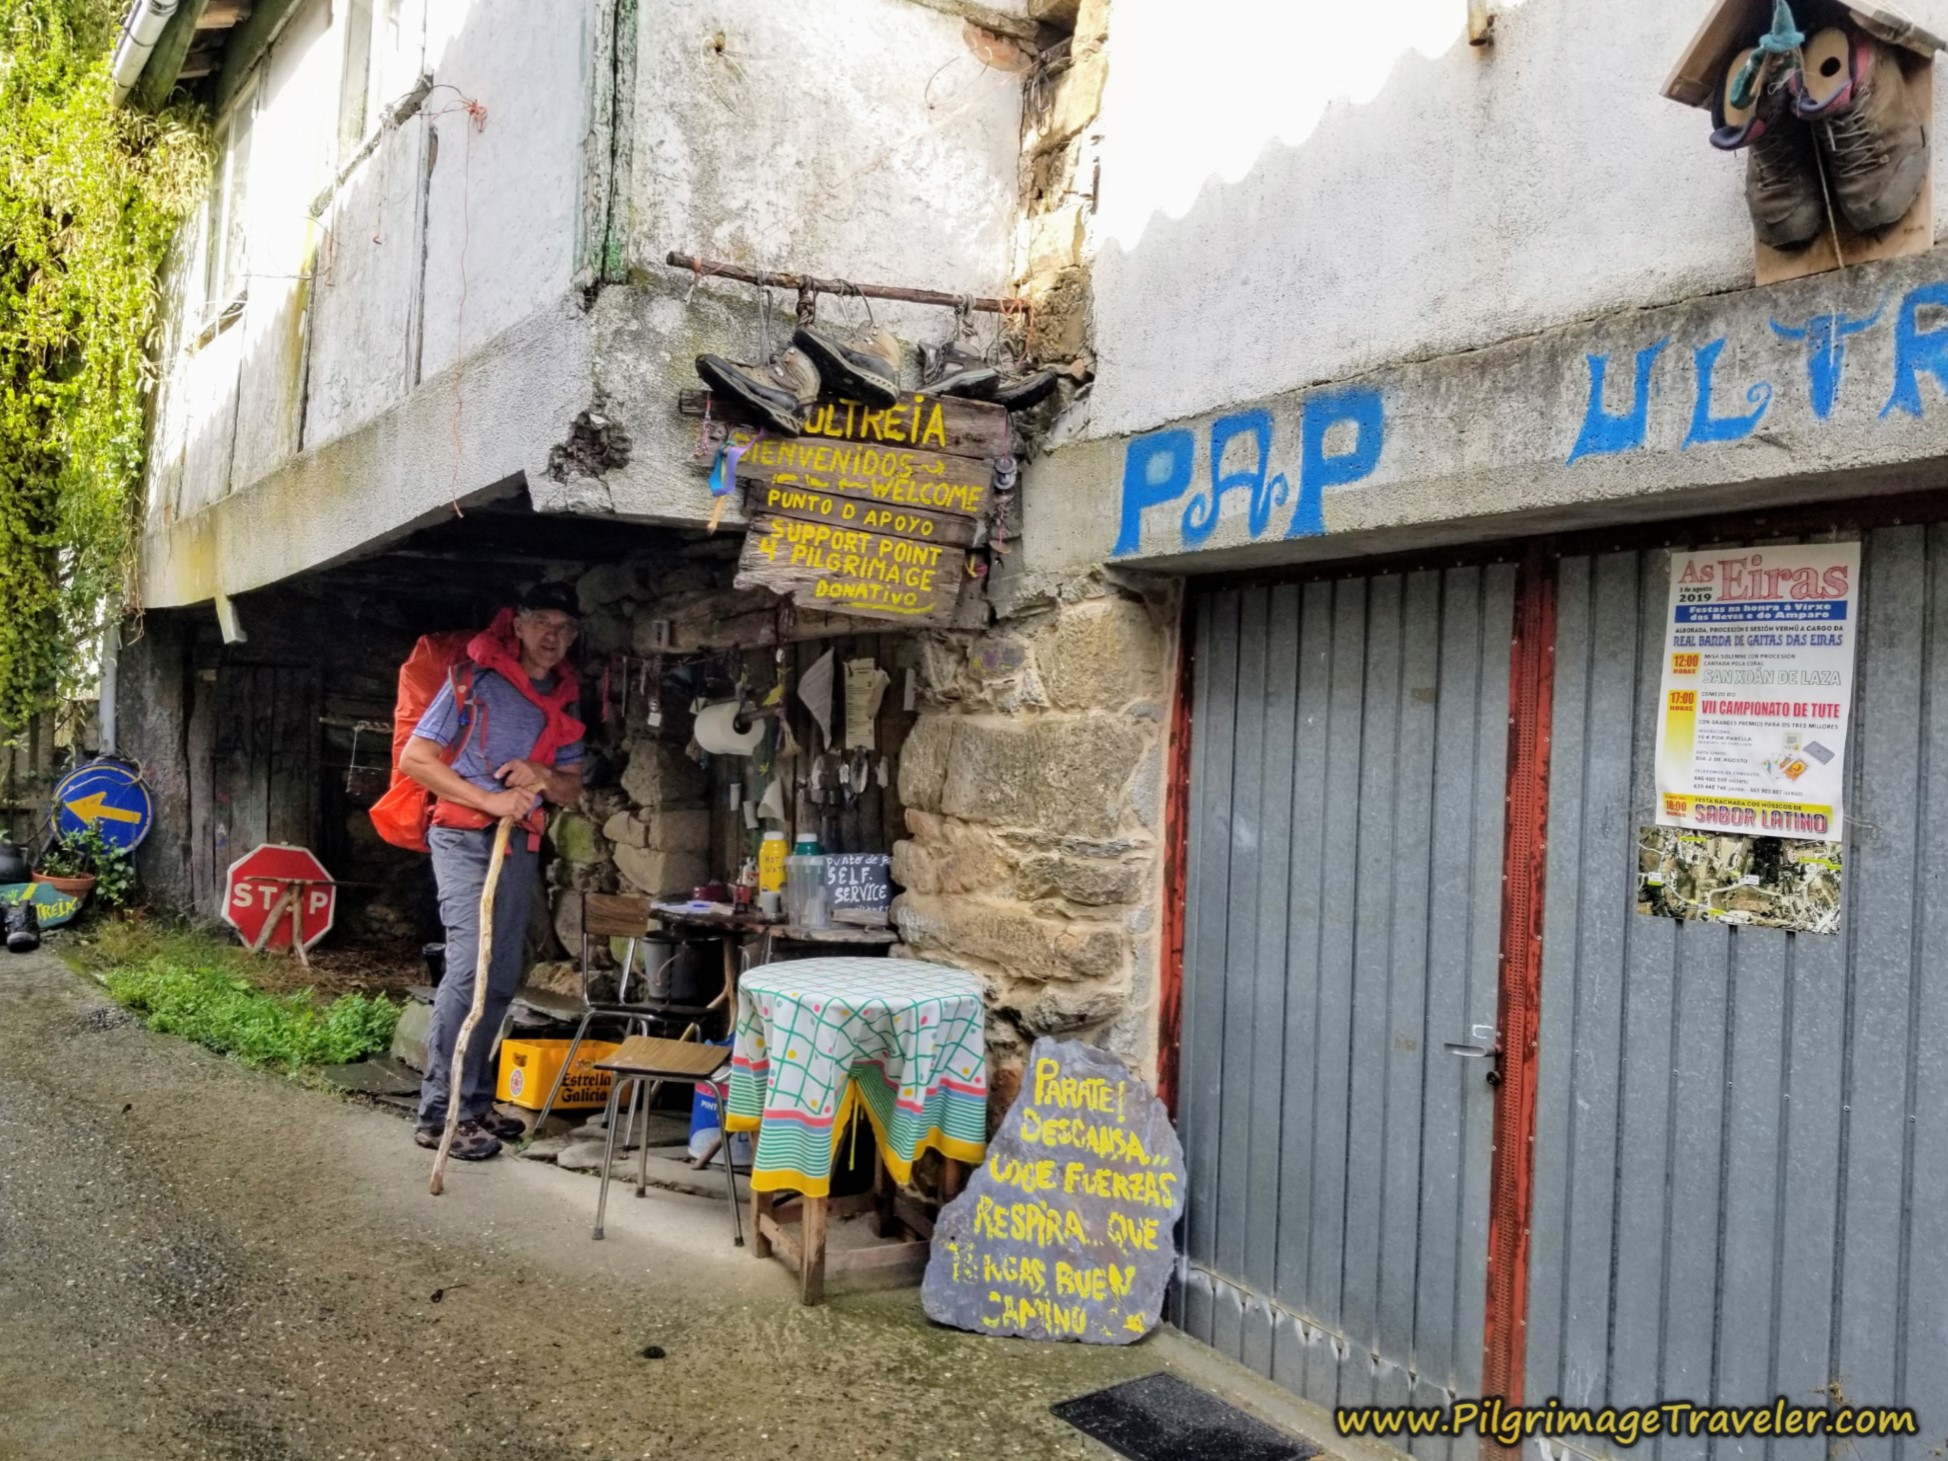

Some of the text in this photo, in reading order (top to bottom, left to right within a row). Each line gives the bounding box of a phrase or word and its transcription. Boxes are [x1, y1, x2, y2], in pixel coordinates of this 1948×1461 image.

[1109, 385, 1385, 558] PAP
[871, 476, 985, 513] WELCOME
[768, 489, 934, 536] PUNTO D APOYO
[771, 519, 943, 566] SUPPORT POINT
[759, 537, 936, 592] 4 PILGRIMAGE
[1678, 554, 1849, 600] As Eiras
[816, 580, 918, 606] DONATIVO
[1679, 593, 1712, 602] 2019
[1692, 586, 1713, 594] agosto
[1689, 606, 1726, 614] Festas
[1743, 604, 1780, 612] honra
[1794, 603, 1832, 611] Virxe
[1774, 611, 1830, 620] Amparo
[1775, 624, 1799, 632] VERMÚ
[1673, 634, 1844, 647] REAL BANDA DE GAITAS DAS EIRAS
[1674, 654, 1699, 668] 12:00
[1703, 669, 1733, 685] SAN
[1778, 669, 1799, 685] DE
[1800, 670, 1842, 686] LAZA
[1671, 691, 1695, 705] 17:00
[1702, 700, 1841, 719] VII CAMPIONATO DE TUTE
[1665, 801, 1687, 812] 18:00
[1695, 803, 1828, 834] SABOR LATINO
[232, 882, 329, 915] STP
[834, 883, 888, 904] SERVICE
[35, 897, 78, 921] TREIA
[561, 1073, 612, 1087] Estrella
[562, 1087, 608, 1103] Galicia
[701, 1099, 718, 1111] PINT
[1062, 1162, 1177, 1209] FUERZAS
[1107, 1211, 1160, 1256] QUE
[1055, 1260, 1137, 1301] BUEN
